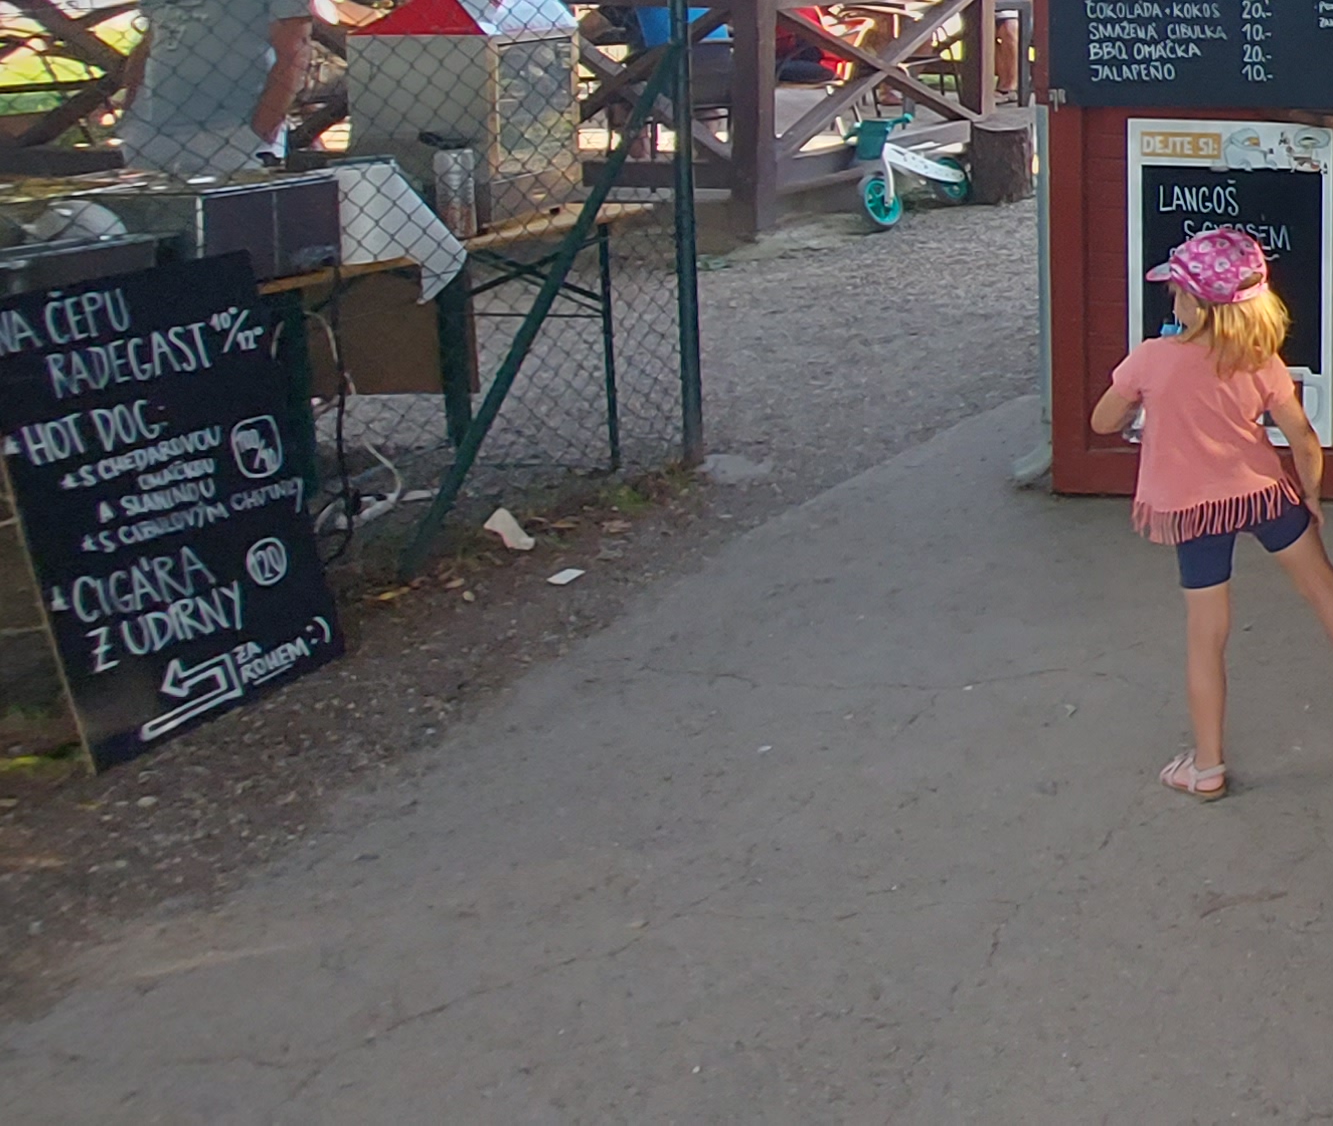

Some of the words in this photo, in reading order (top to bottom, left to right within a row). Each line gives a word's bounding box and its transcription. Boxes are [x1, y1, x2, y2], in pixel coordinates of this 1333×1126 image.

[1084, 0, 1162, 19] ČOKOLÁDA
[1172, 2, 1221, 19] KOKOS
[1089, 21, 1159, 40] SMAŽENÁ
[1167, 23, 1228, 41] CIBULKA
[1089, 41, 1129, 60] BBQ
[1133, 39, 1201, 60] OMÁČKA
[1090, 61, 1176, 82] JALAPEÑO
[1141, 135, 1193, 154] DEJTE
[1197, 136, 1218, 156] SI:
[1159, 180, 1239, 216] LANGOŠ
[44, 288, 130, 345] ČEPU
[46, 322, 213, 399] RADEGAST
[21, 412, 85, 466] HOT
[72, 545, 216, 623] CIGÁRA
[232, 641, 263, 664] ZA
[241, 637, 310, 684] ROHEM
